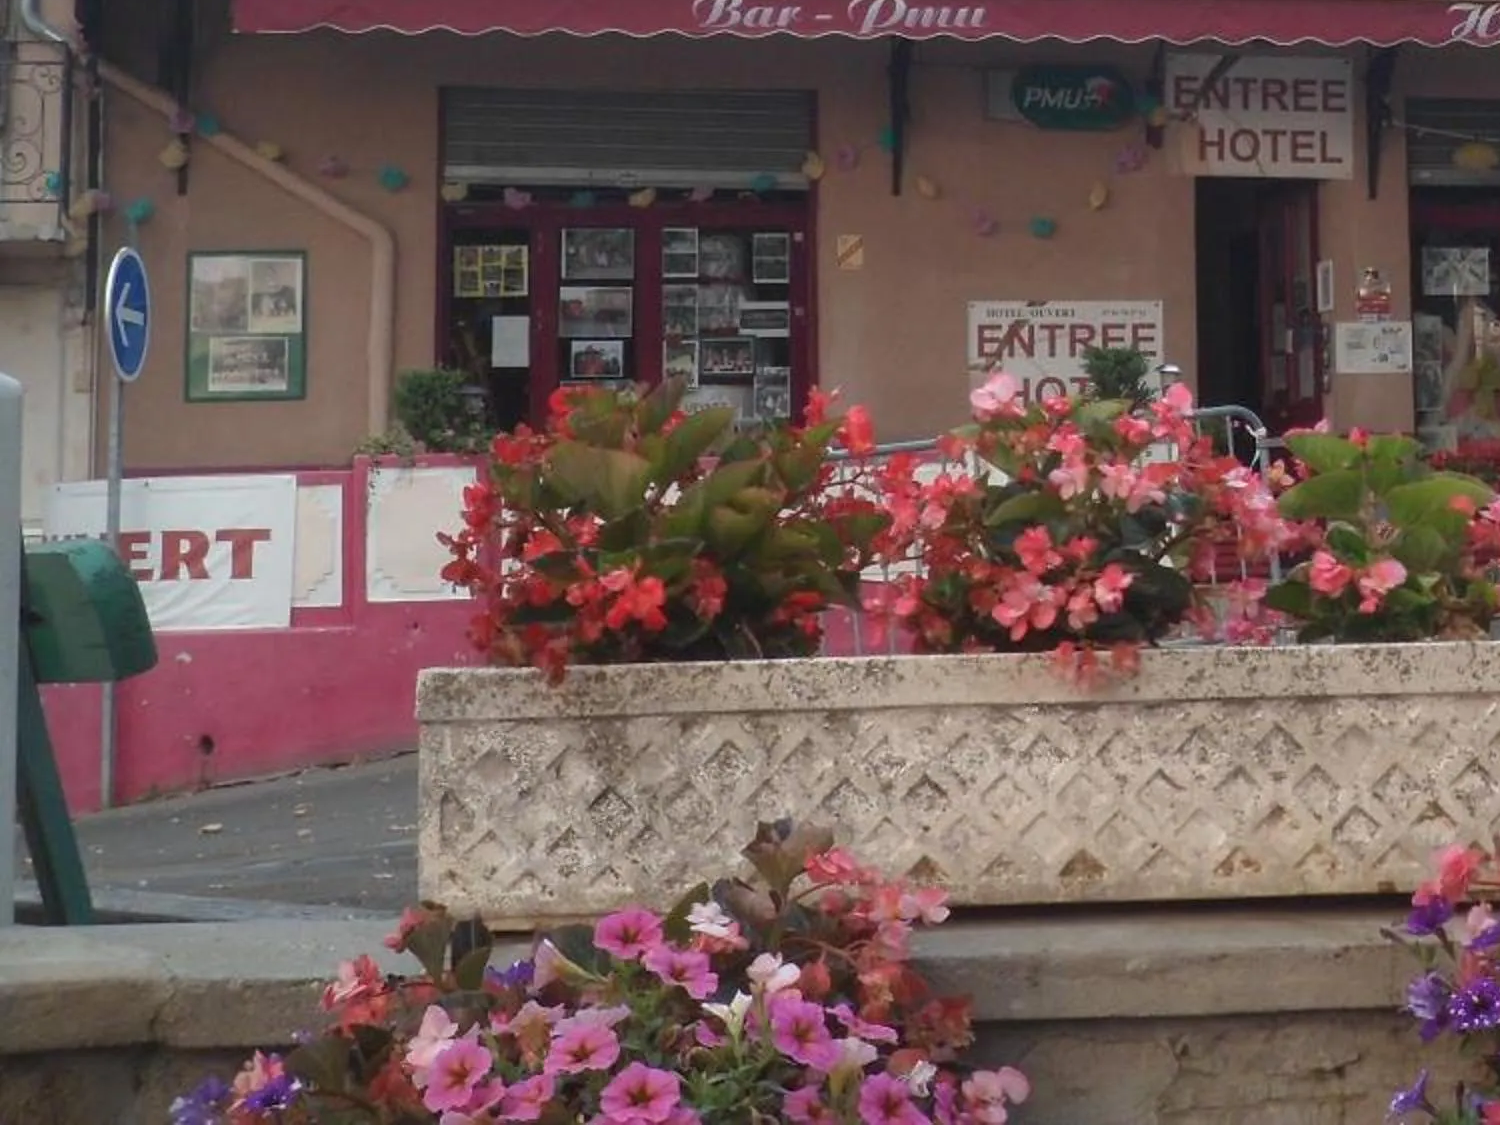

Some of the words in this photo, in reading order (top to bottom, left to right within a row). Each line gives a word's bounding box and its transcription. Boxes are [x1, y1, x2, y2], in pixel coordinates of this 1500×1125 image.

[1023, 86, 1085, 110] PMU
[1173, 74, 1348, 113] ENTREE
[1199, 128, 1344, 165] HOTEL
[977, 322, 1157, 359] ENTREE
[104, 528, 272, 582] ERT
